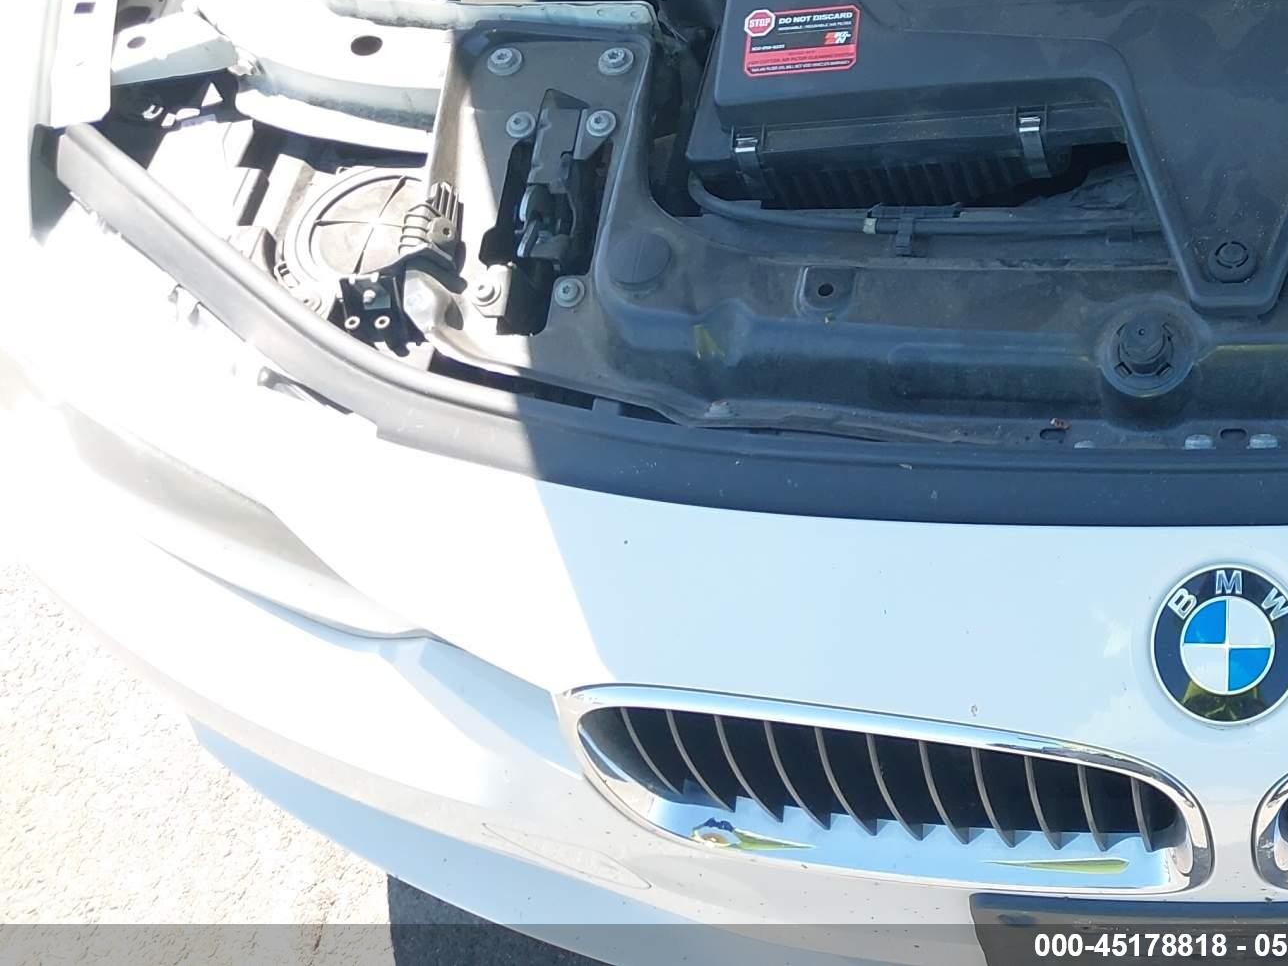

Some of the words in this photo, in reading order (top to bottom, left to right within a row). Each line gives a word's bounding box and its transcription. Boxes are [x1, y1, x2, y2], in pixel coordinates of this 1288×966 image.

[749, 17, 771, 28] STOP
[793, 15, 812, 23] NOT
[812, 12, 853, 21] DISCARD
